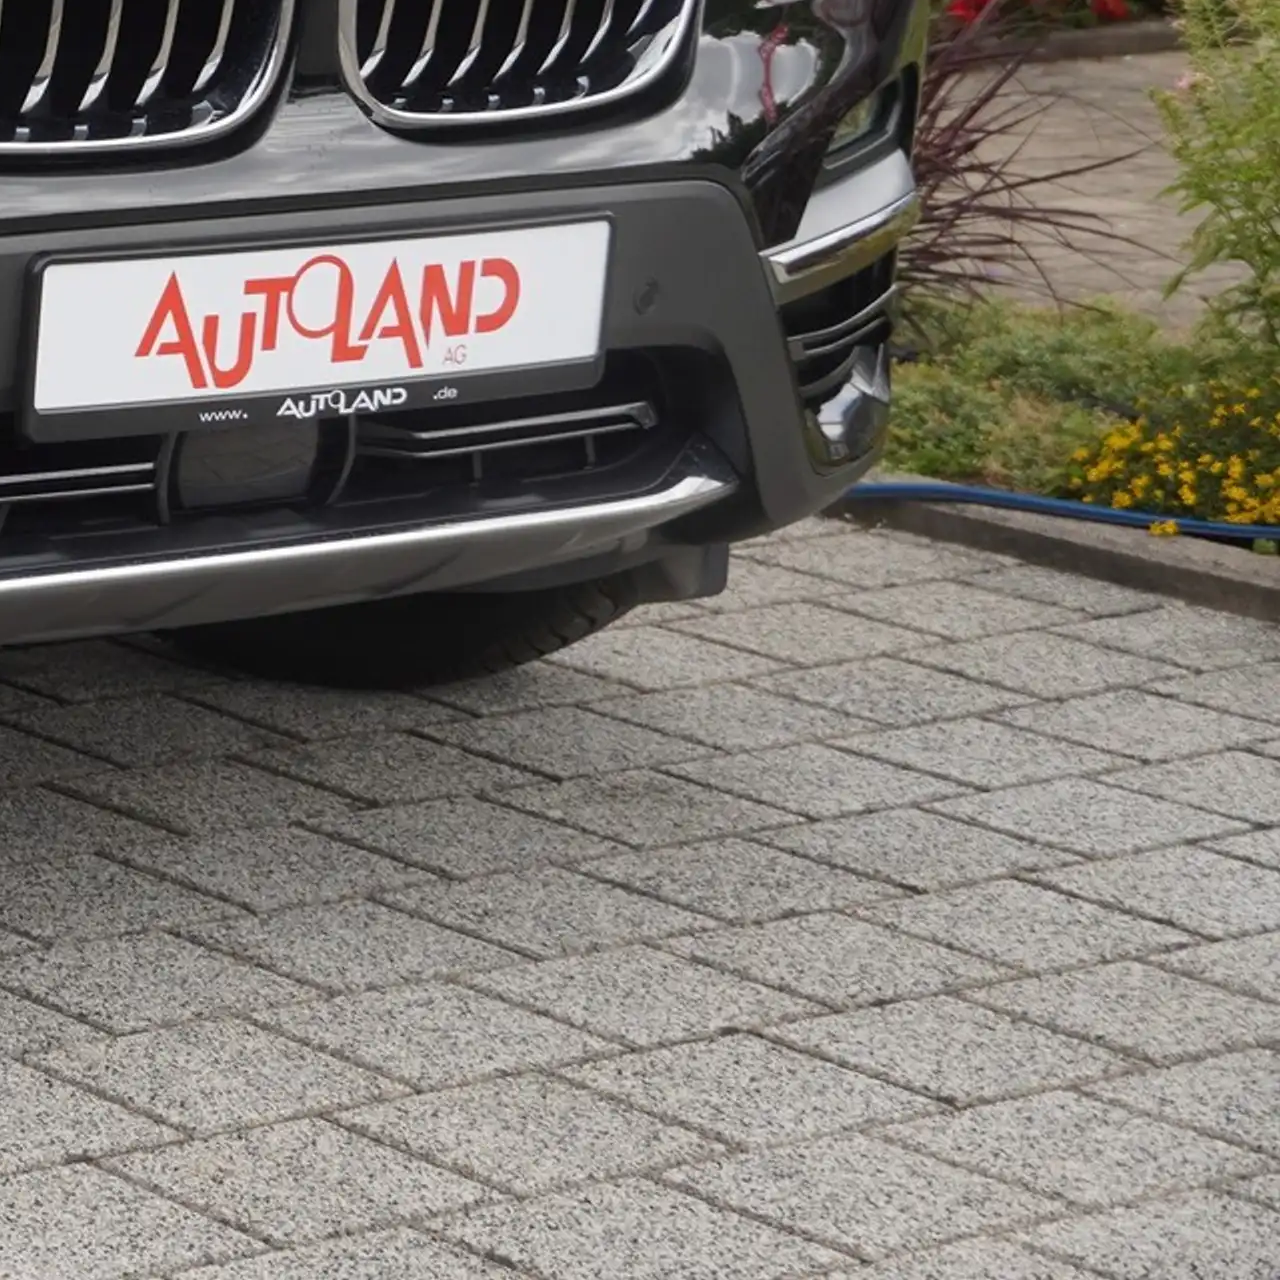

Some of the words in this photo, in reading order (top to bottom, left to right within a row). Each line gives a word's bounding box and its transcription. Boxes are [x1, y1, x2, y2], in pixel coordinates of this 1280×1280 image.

[134, 253, 521, 389] AUTOLAND
[443, 344, 468, 367] AG
[198, 411, 248, 423] www.
[276, 387, 407, 420] AUTOLAND
[433, 386, 458, 401] .de
